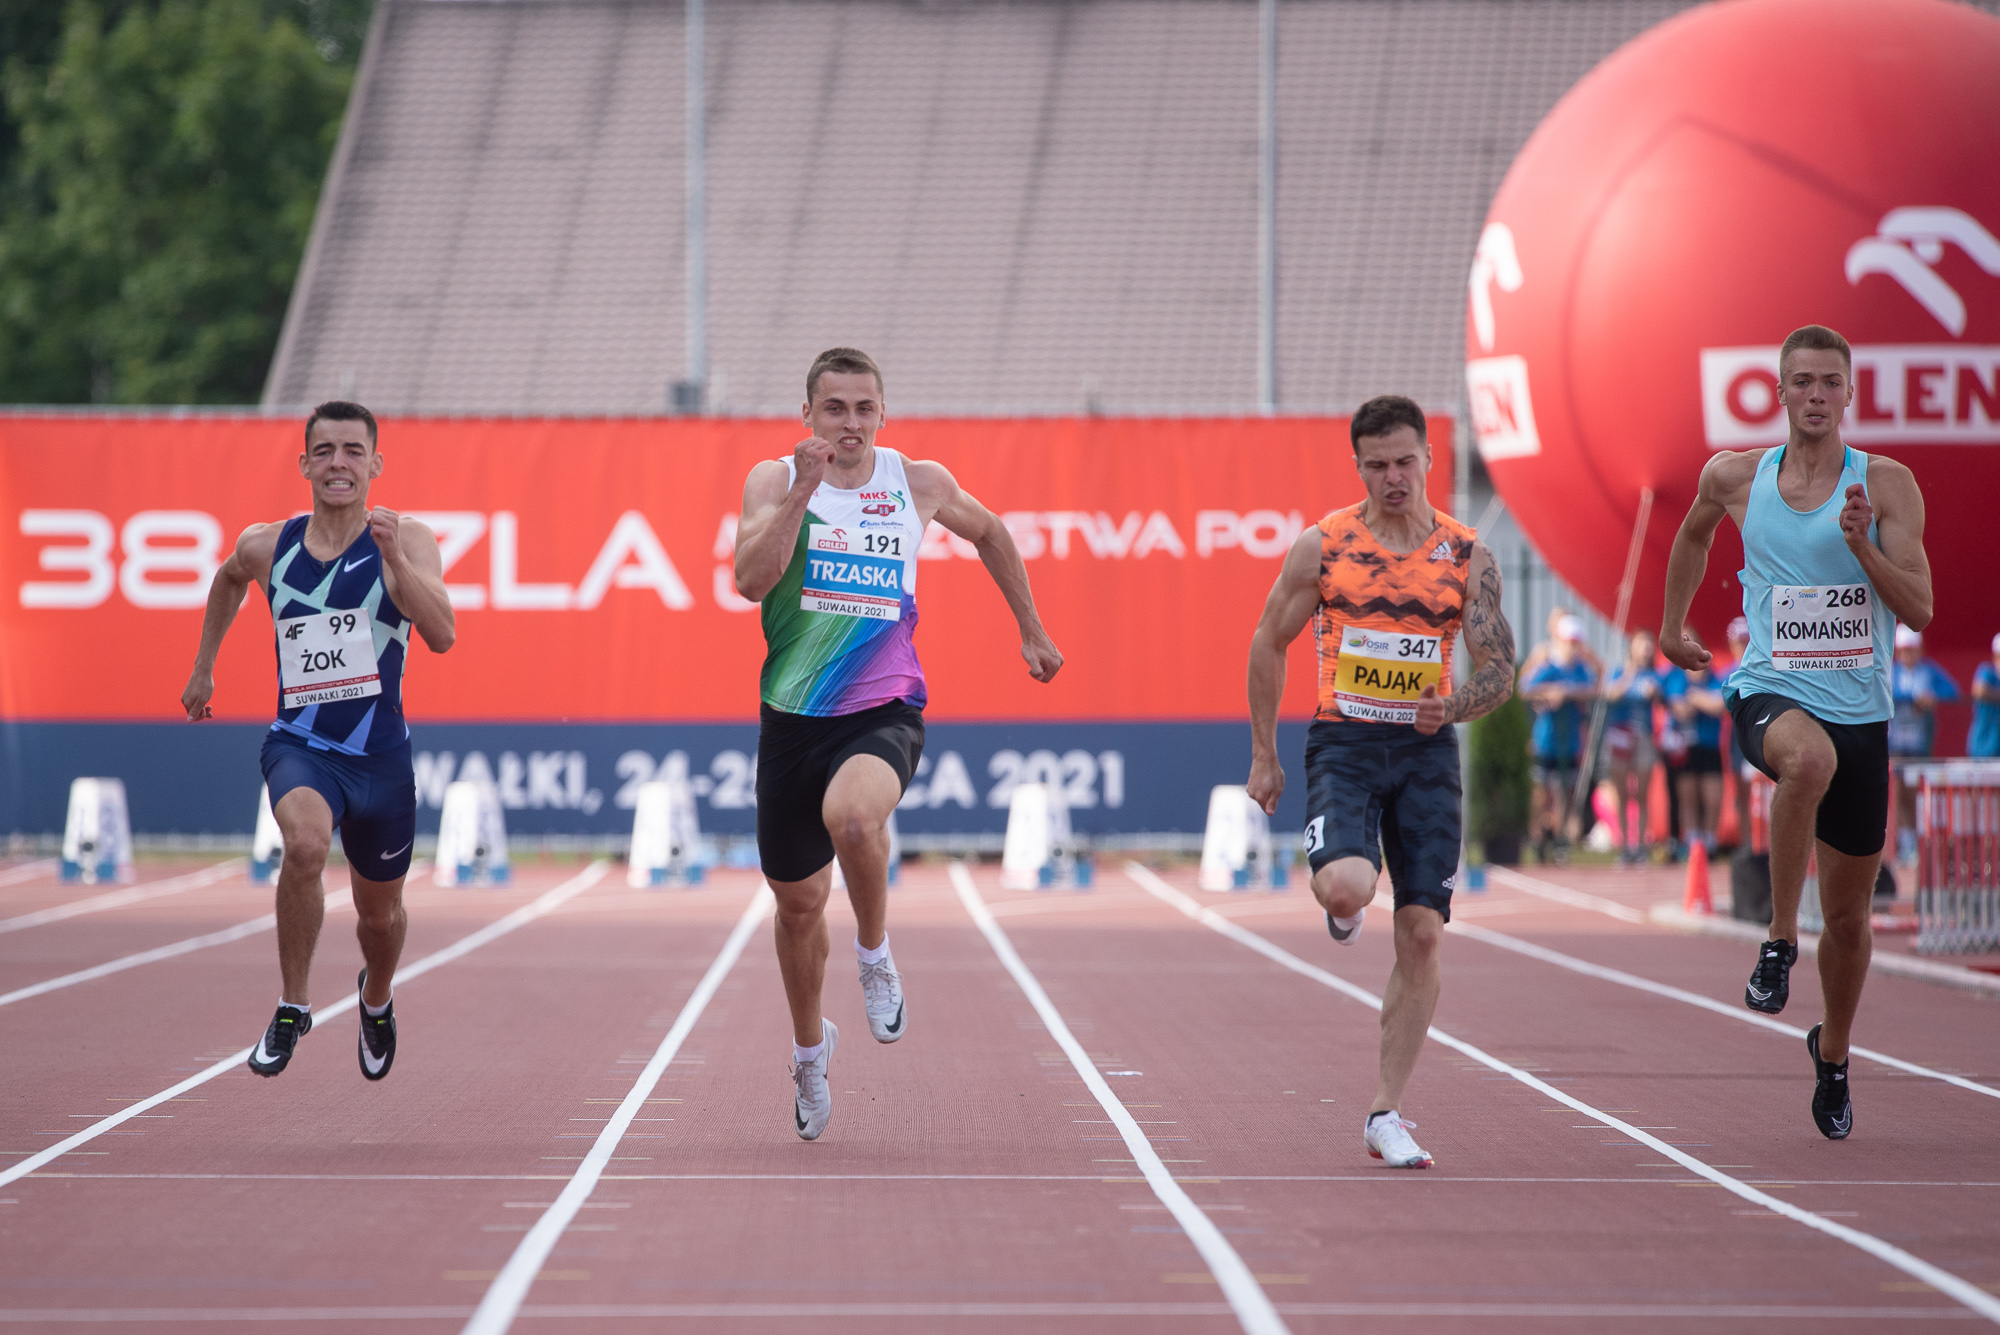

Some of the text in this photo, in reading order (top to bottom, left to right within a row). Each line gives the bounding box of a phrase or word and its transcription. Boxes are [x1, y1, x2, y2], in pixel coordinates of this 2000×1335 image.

[1725, 365, 2000, 426] OLEN
[860, 491, 888, 500] MKS
[819, 541, 847, 550] ORLEN
[864, 534, 901, 556] 191
[19, 508, 249, 609] 38
[398, 508, 693, 611] ZLA
[809, 559, 898, 589] TRZASKA
[1826, 587, 1866, 608] 268
[816, 601, 886, 617] SUWAŁKI 2021
[285, 622, 306, 640] 4F
[329, 614, 356, 635] 99
[1776, 617, 1869, 640] KOMAŃSKI
[1366, 640, 1389, 651] OSIR
[1398, 638, 1437, 659] 347
[300, 648, 347, 673] ŻOK
[1788, 658, 1858, 669] SUWAŁKI 2021
[1354, 665, 1423, 694] PAJĄK
[295, 687, 364, 705] SUWAŁKI 2021
[1347, 704, 1416, 721] SUWAŁKI 202
[414, 749, 603, 815] WAŁKI,
[612, 748, 758, 810] 24-2
[1307, 824, 1317, 854] 3
